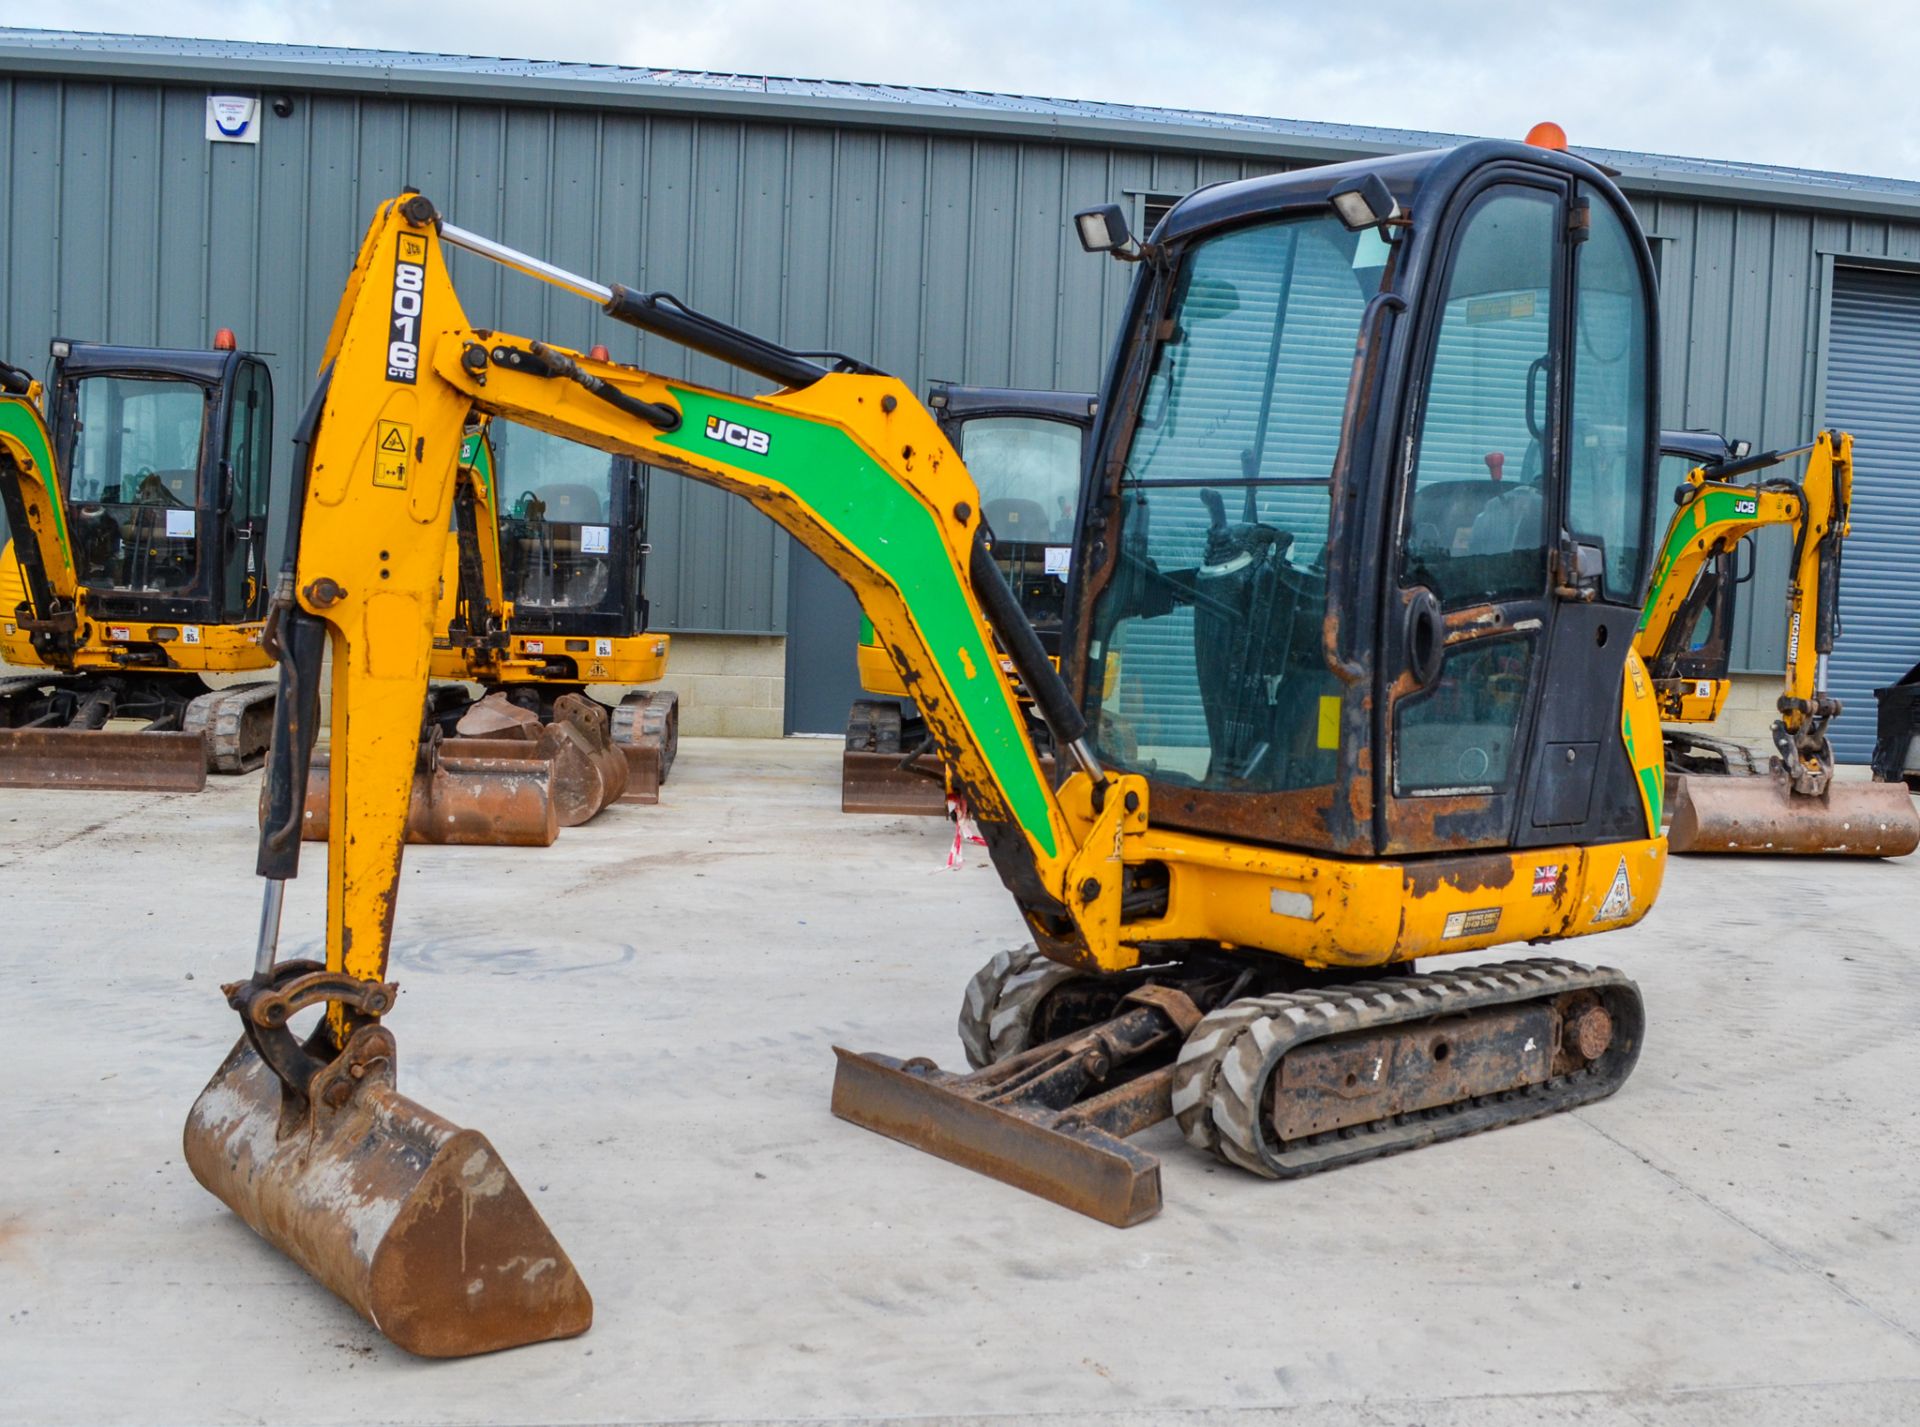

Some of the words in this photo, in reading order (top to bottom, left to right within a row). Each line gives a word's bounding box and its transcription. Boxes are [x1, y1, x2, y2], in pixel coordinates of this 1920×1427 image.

[388, 263, 424, 370] 8016
[388, 366, 415, 379] CTS
[706, 418, 770, 454] JCB
[1735, 500, 1756, 514] JCB
